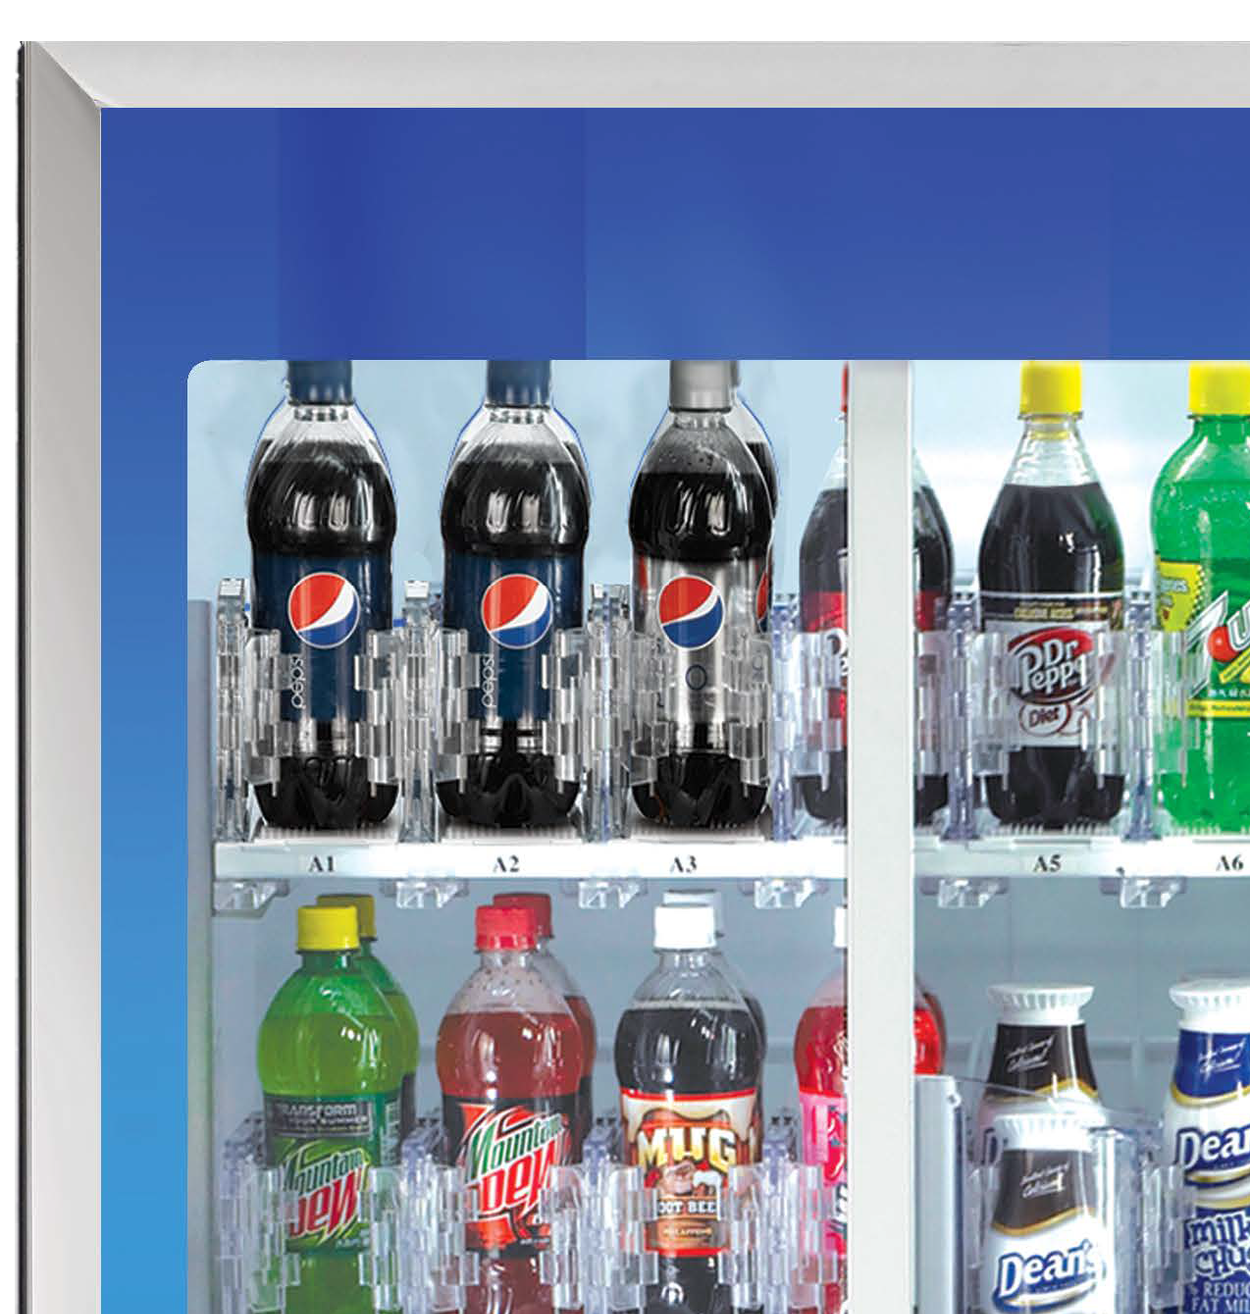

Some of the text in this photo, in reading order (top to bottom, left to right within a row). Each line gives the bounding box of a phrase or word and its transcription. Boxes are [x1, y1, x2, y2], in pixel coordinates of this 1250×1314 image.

[1043, 638, 1078, 663] Dr
[308, 856, 335, 873] A1
[493, 856, 519, 873] A2
[671, 856, 697, 873] A3
[1033, 855, 1061, 872] A5
[1216, 855, 1244, 872] A6
[637, 1127, 737, 1175] MUG
[1192, 1298, 1219, 1313] FAT
